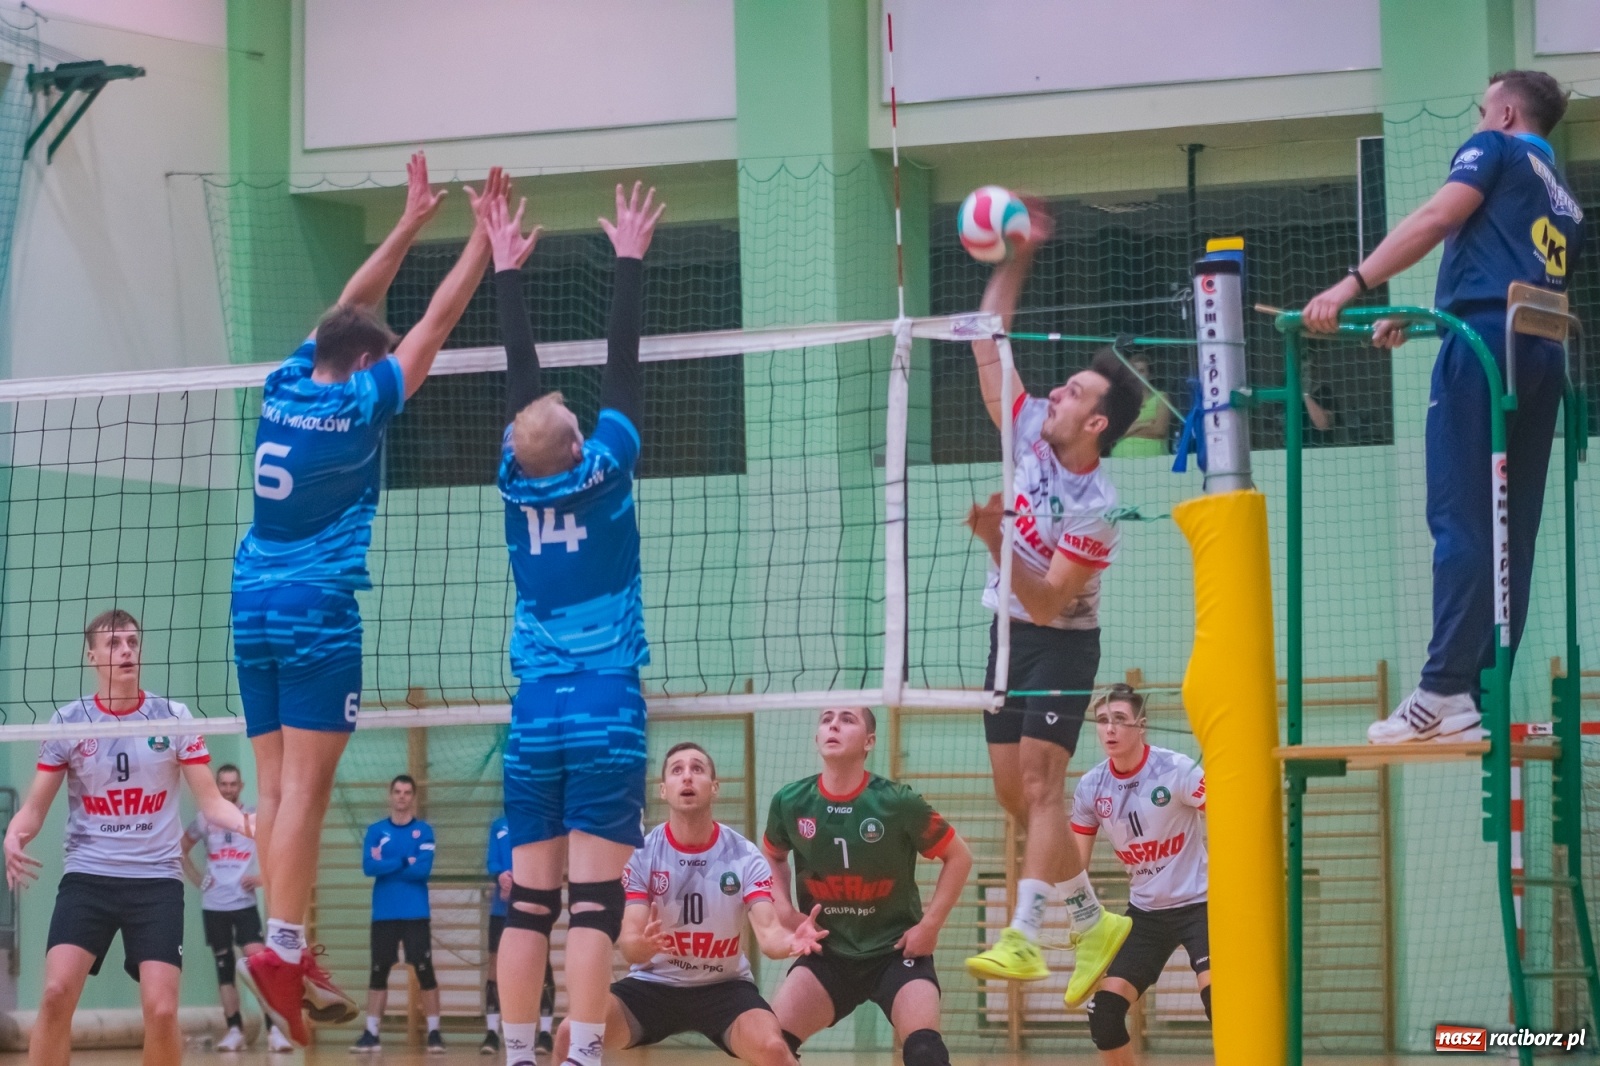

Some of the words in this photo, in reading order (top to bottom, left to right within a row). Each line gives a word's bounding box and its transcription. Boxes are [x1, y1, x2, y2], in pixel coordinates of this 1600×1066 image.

[254, 441, 293, 500] 6
[520, 506, 588, 555] 14
[345, 693, 358, 723] 6
[116, 752, 130, 782] 9
[100, 824, 131, 833] GRUPA
[136, 822, 153, 831] PBG
[1128, 811, 1144, 837] 11
[834, 838, 850, 869] 7
[683, 893, 704, 925] 10
[823, 906, 856, 915] GRUPA
[858, 906, 876, 916] PBG
